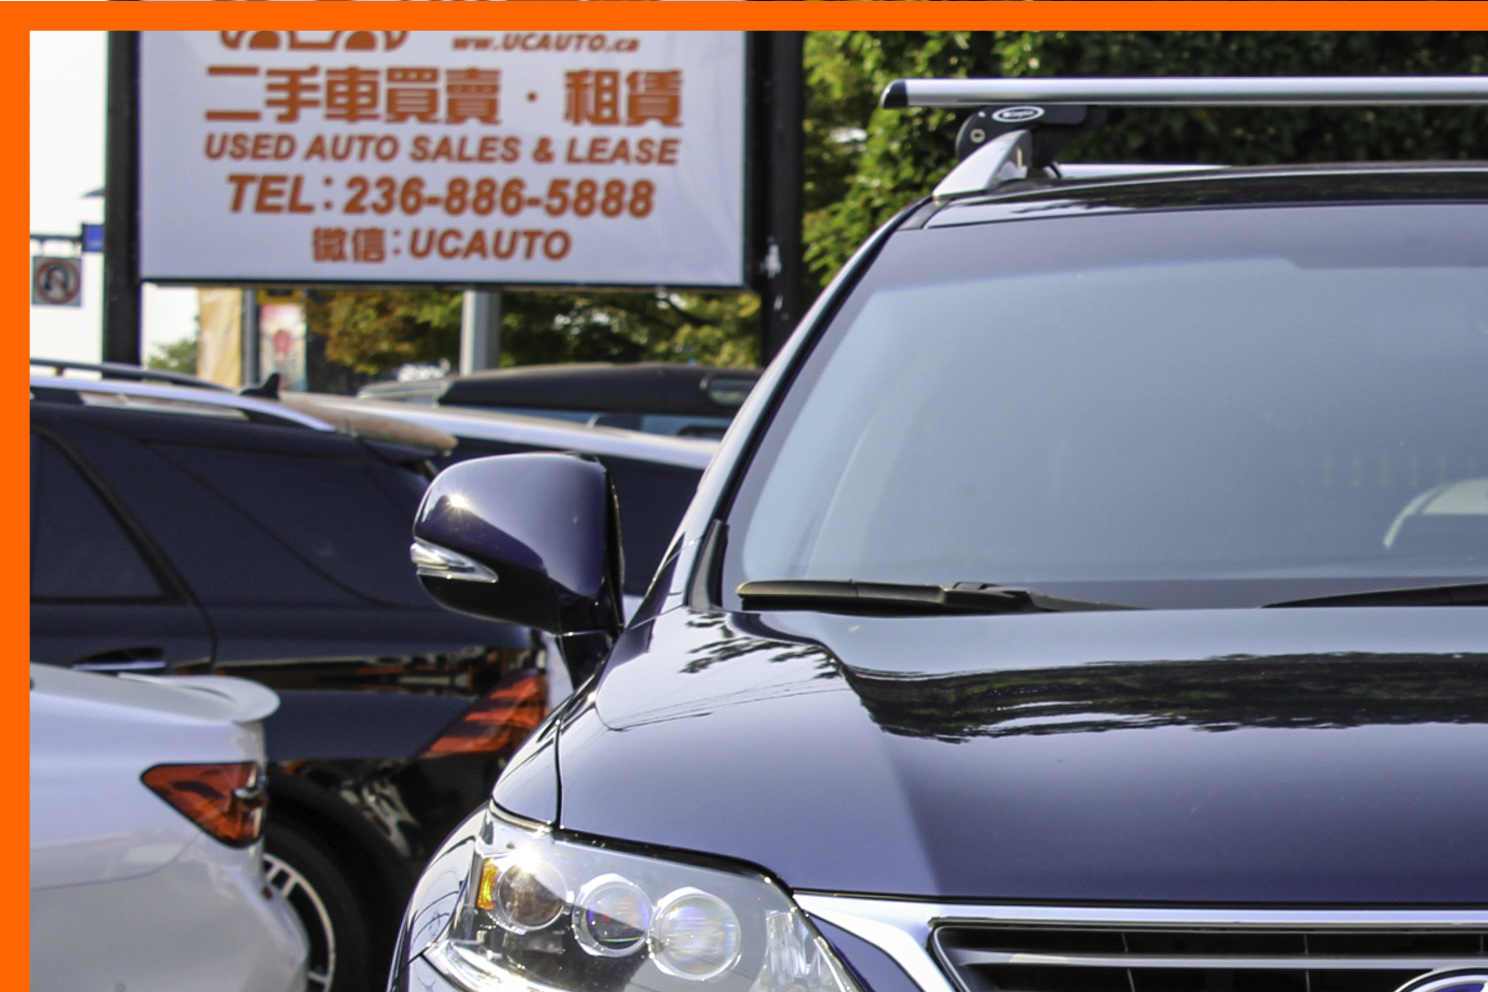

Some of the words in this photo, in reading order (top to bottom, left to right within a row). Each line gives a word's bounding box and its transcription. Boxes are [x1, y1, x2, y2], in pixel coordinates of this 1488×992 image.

[205, 133, 297, 160] USED
[303, 134, 400, 161] AUTO
[410, 135, 521, 164] SALES
[532, 137, 555, 164] &
[565, 137, 681, 166] LEASE
